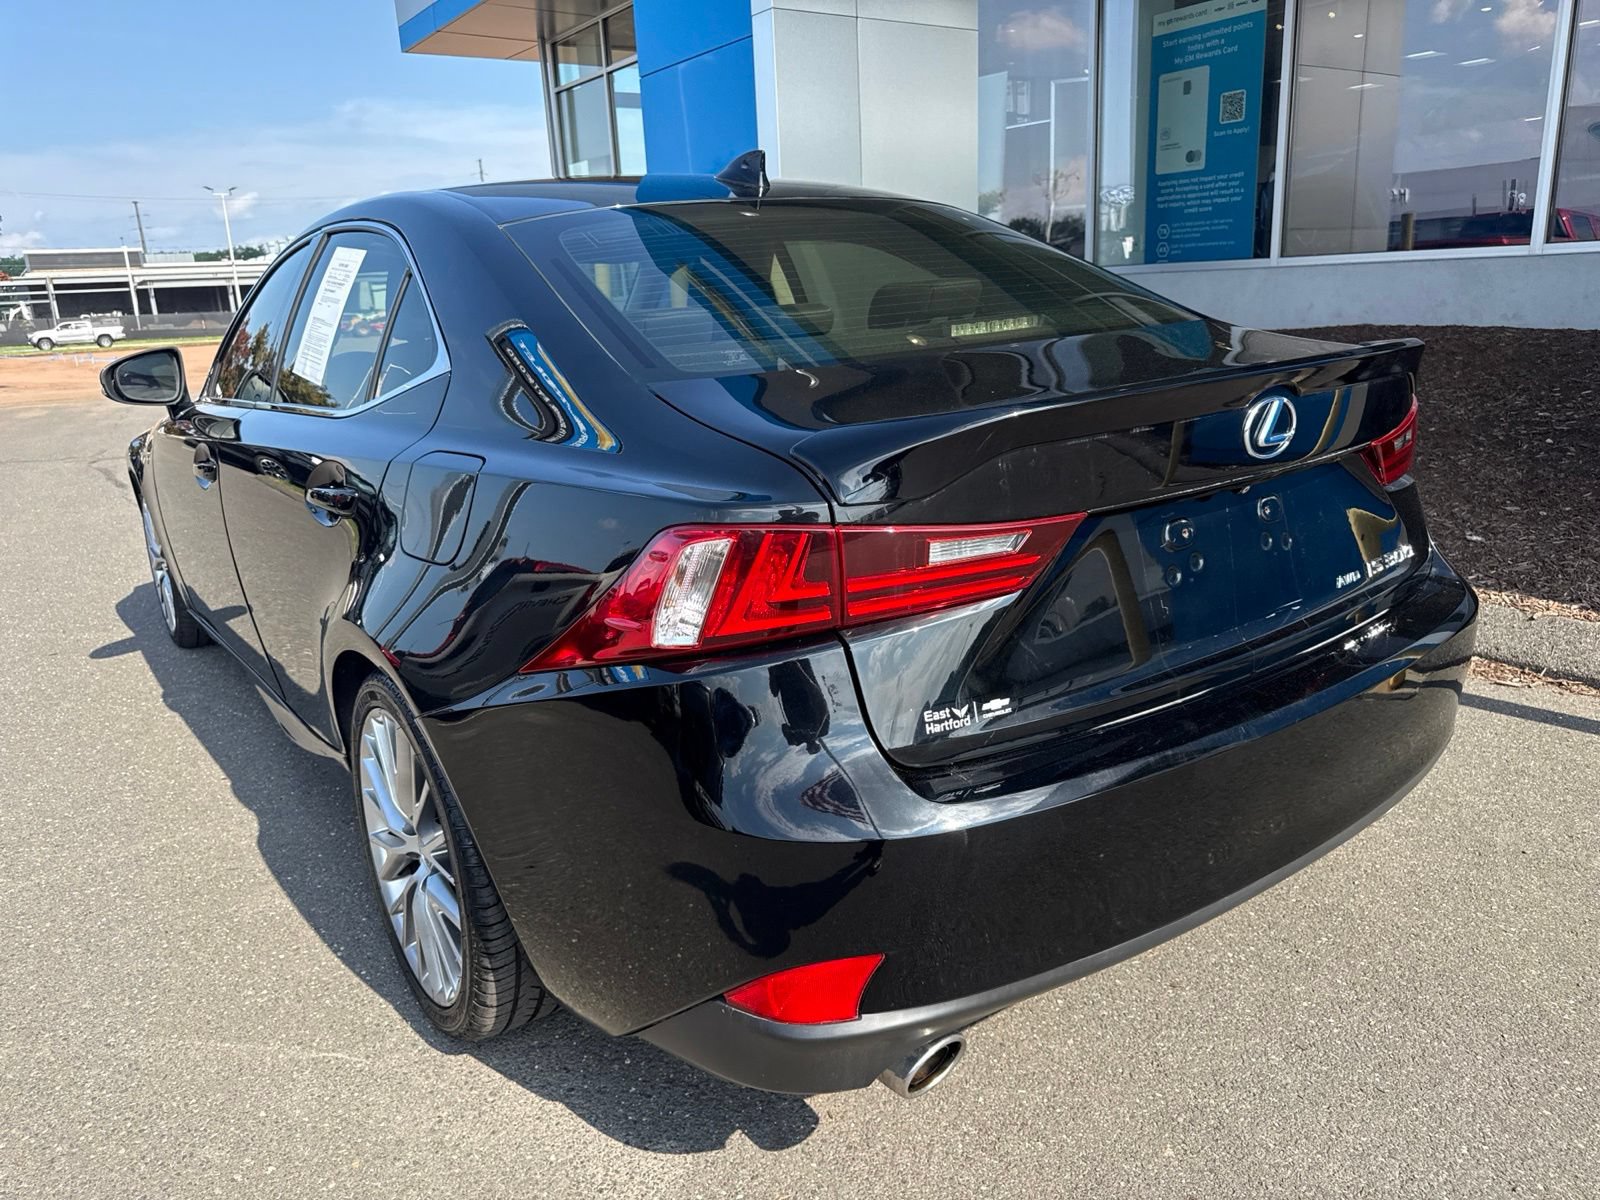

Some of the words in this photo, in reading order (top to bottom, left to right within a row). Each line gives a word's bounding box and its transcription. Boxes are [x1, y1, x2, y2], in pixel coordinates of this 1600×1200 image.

[1195, 8, 1208, 18] card
[1162, 39, 1178, 48] Start
[1179, 33, 1202, 45] earning
[1203, 26, 1231, 39] unlimited
[1233, 21, 1253, 32] points
[1187, 42, 1204, 52] today
[1206, 38, 1220, 48] with
[1174, 57, 1184, 66] My
[1184, 54, 1195, 63] GM
[1196, 48, 1222, 59] Rewards
[1223, 44, 1239, 54] Card
[1233, 125, 1250, 135] Apply!
[923, 707, 952, 722] East
[925, 714, 971, 734] Hartford
